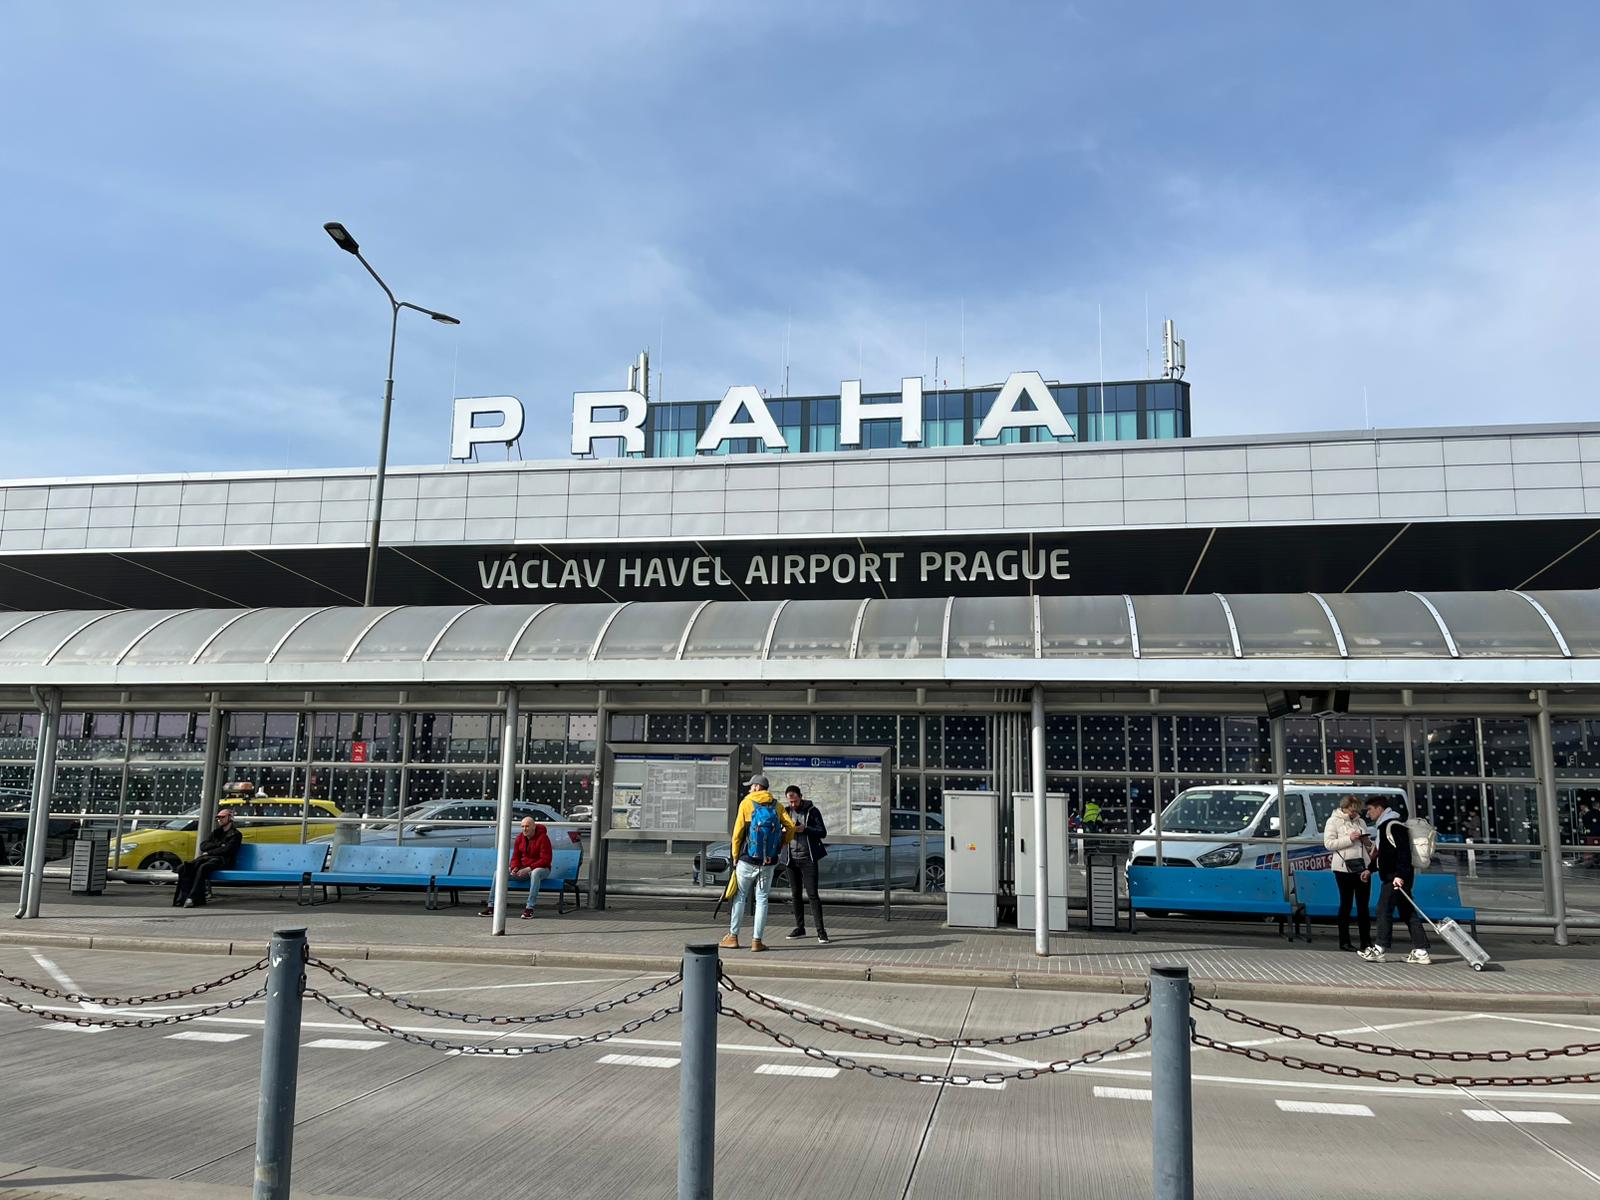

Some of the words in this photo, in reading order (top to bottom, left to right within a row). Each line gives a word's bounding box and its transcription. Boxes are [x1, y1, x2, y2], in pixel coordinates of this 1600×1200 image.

[451, 371, 1075, 460] PRAHA
[477, 552, 607, 590] VÁCLAV
[617, 555, 733, 589] HAVEL
[744, 551, 904, 587] AIRPORT
[919, 548, 1072, 583] PRAGUE
[1289, 855, 1327, 874] AIRPORT
